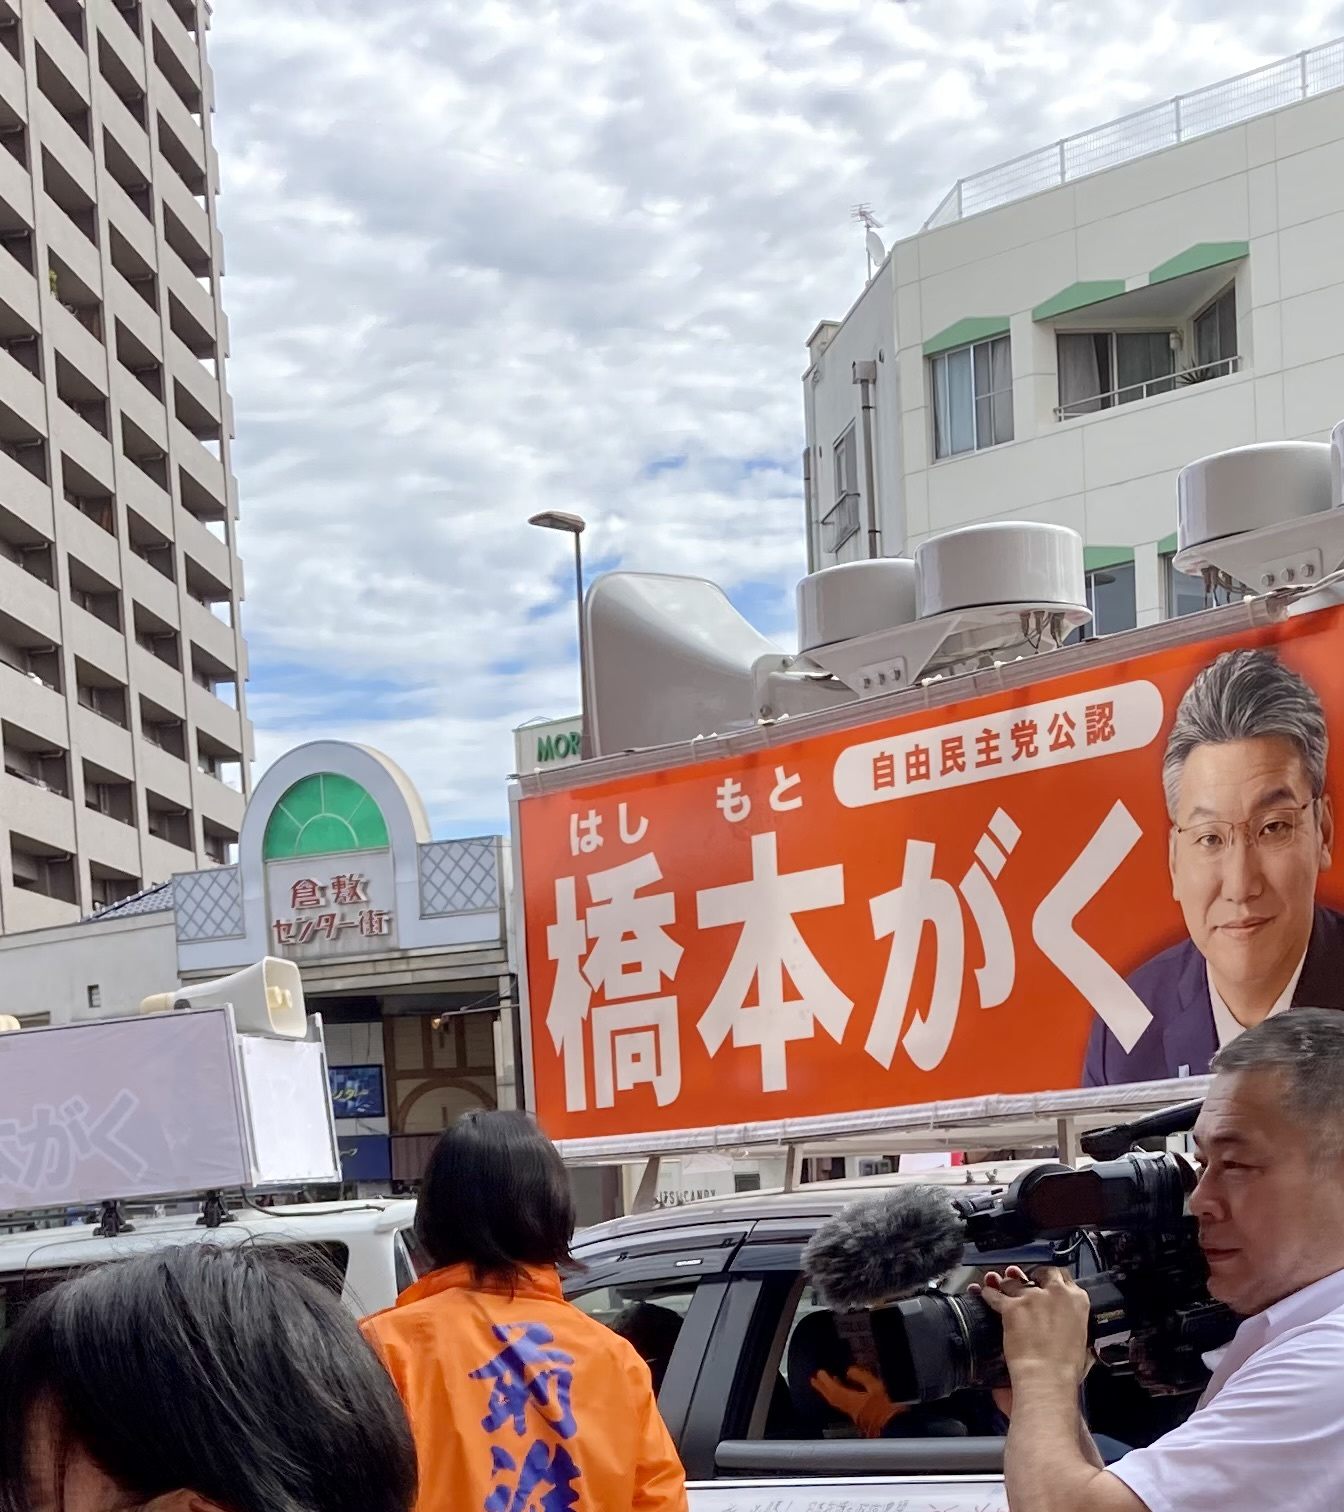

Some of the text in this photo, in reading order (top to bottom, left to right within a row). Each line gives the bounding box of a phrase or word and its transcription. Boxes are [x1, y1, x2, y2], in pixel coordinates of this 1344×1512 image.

[870, 700, 1118, 793] 自由民主党公認
[569, 766, 805, 857] はし もと
[272, 908, 393, 945] センター街
[290, 872, 370, 910] 倉敷
[544, 798, 1155, 1114] 橋本がく
